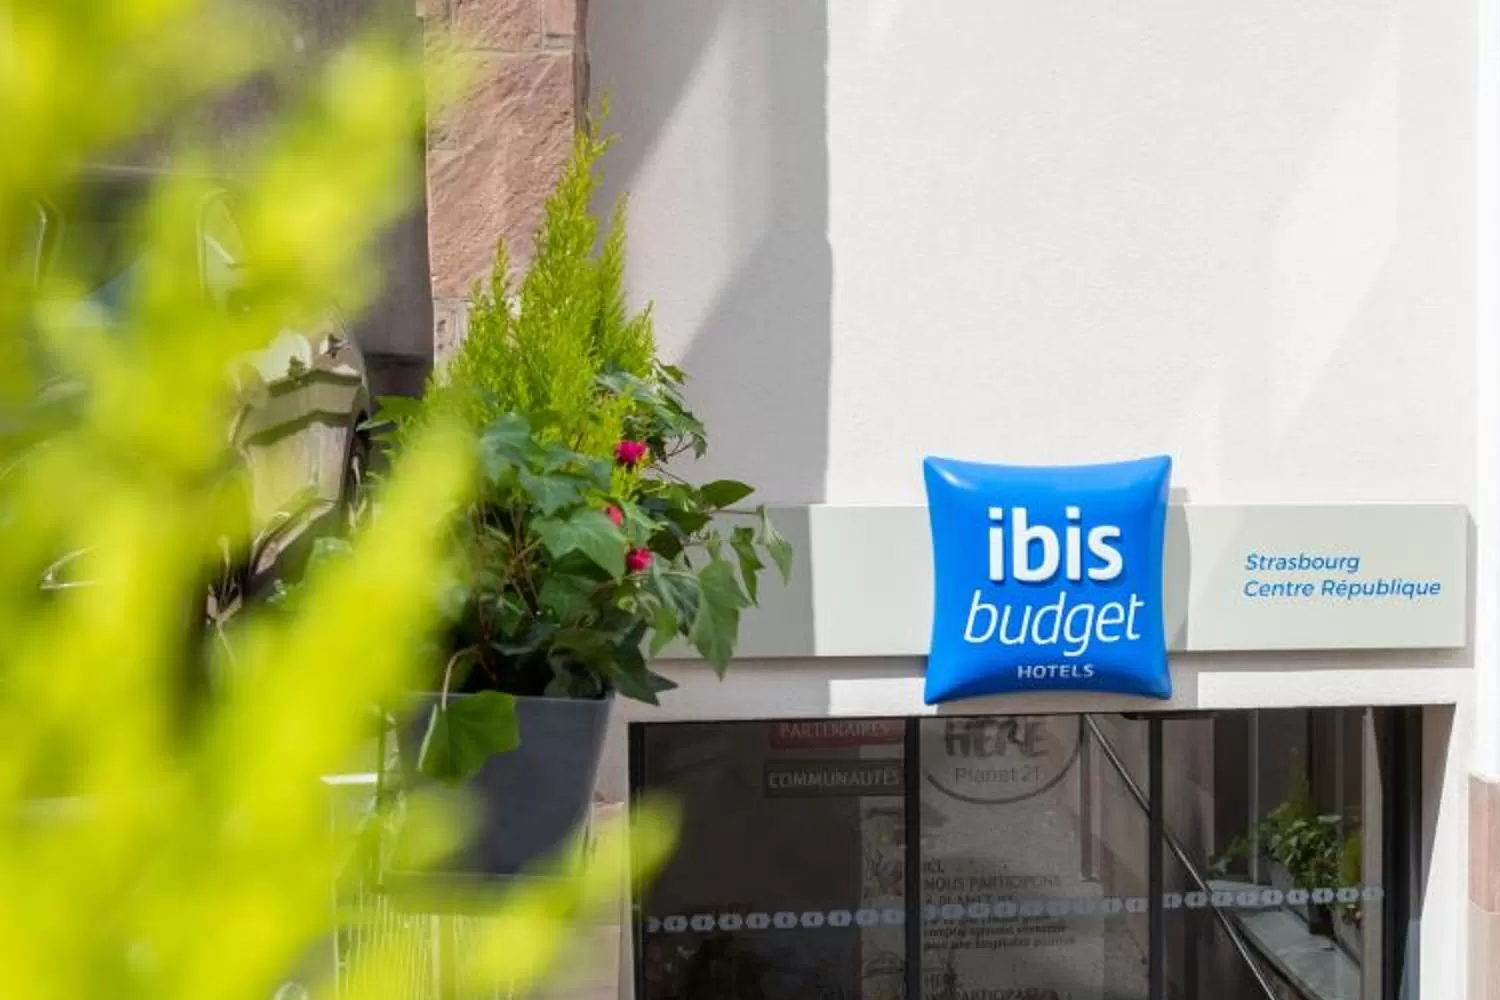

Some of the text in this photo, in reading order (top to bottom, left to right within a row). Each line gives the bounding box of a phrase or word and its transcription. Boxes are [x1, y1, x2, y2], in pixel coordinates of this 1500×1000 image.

[988, 506, 1123, 582] ibis
[1246, 552, 1360, 574] Strasbourg
[1243, 578, 1441, 600] Centre République
[963, 589, 1144, 657] budget
[1017, 663, 1095, 679] HOTELS
[955, 767, 1016, 784] Planet
